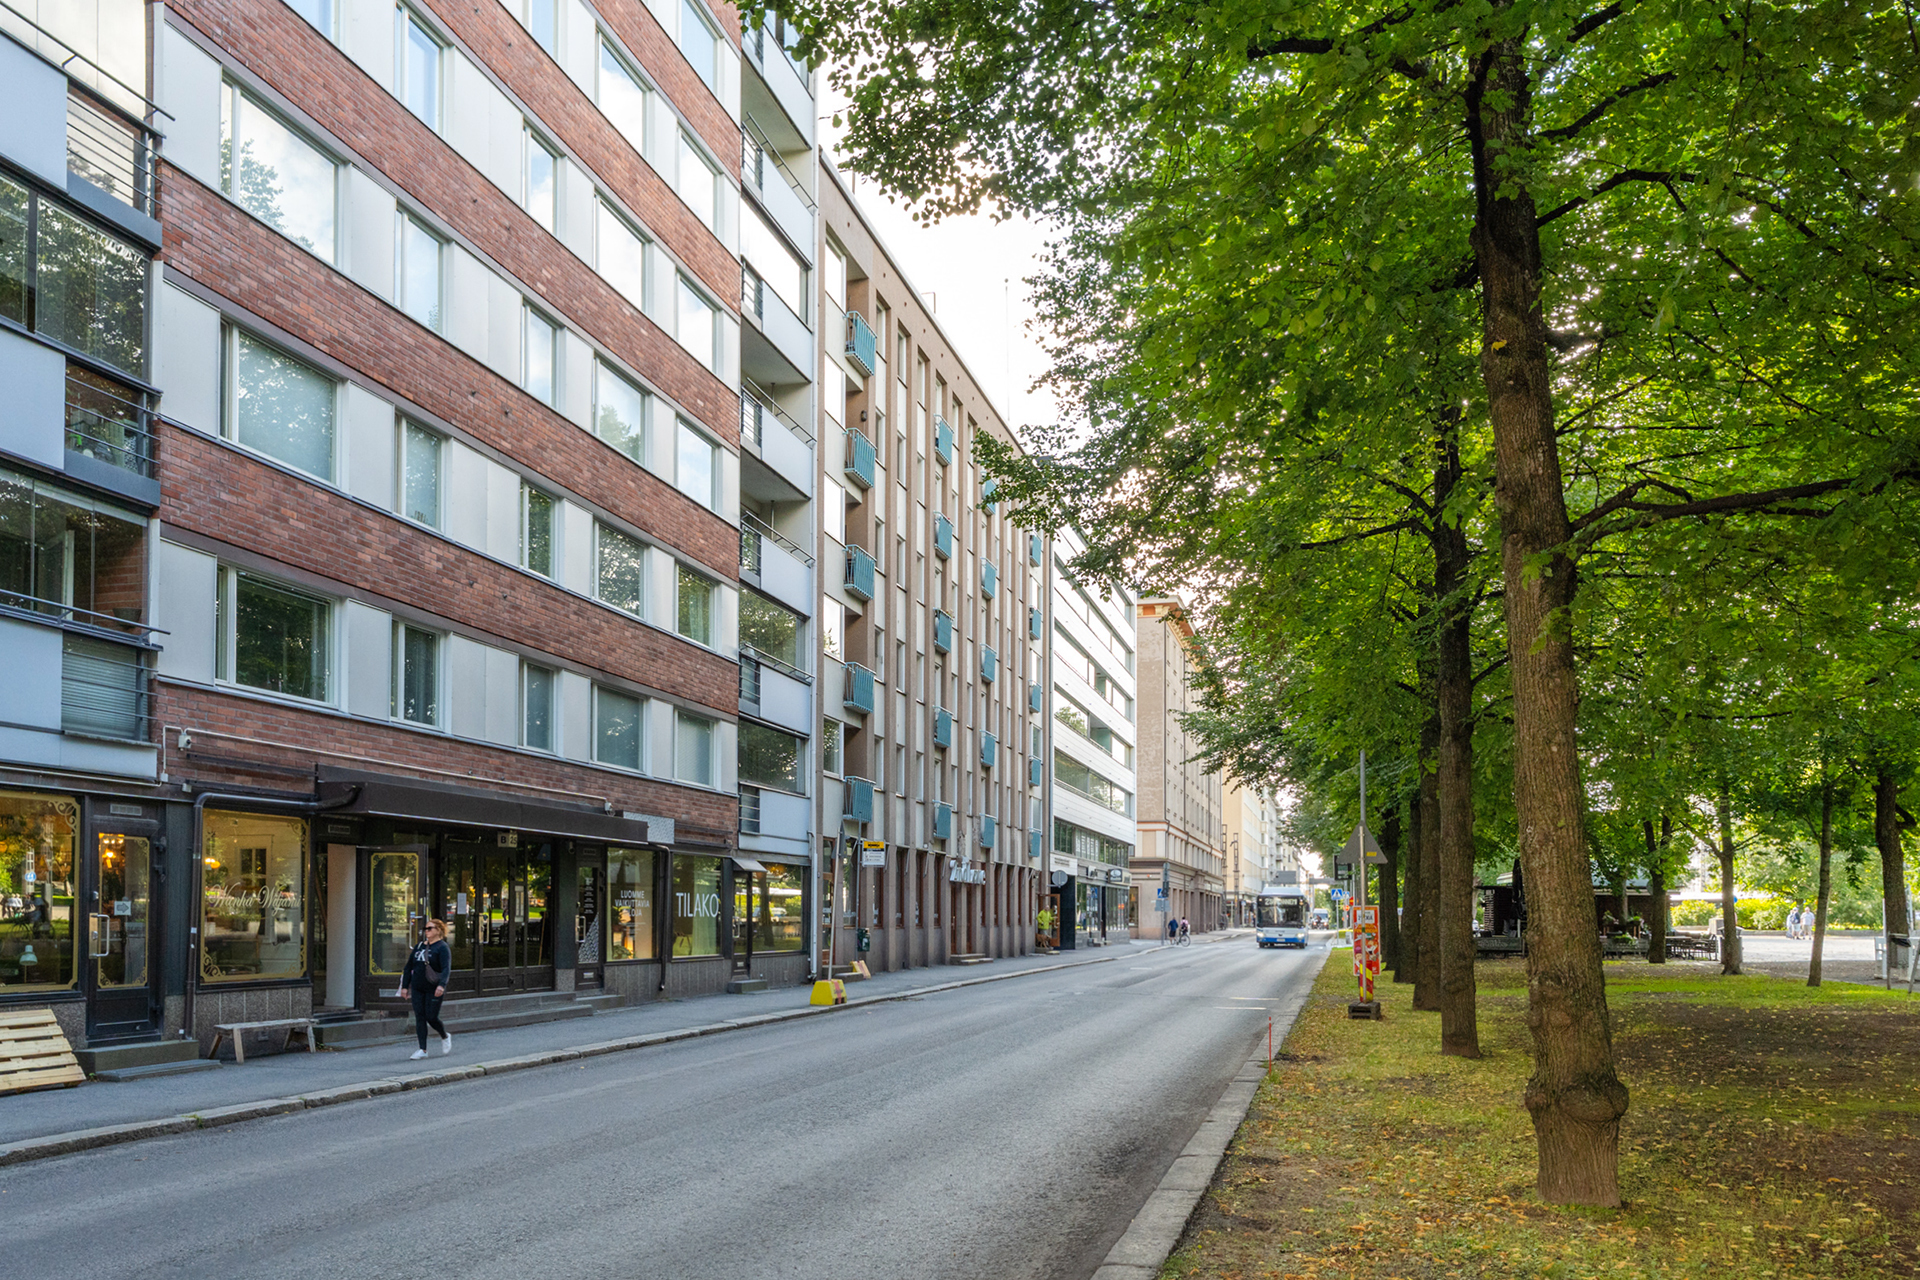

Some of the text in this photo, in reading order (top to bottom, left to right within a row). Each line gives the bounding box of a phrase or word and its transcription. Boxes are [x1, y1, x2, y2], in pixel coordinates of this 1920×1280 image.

[501, 836, 507, 844] B
[208, 882, 255, 907] Wanha
[620, 890, 645, 899] LUOMME
[615, 899, 650, 908] VAIKUTTAVIA
[676, 892, 719, 918] TILAKO
